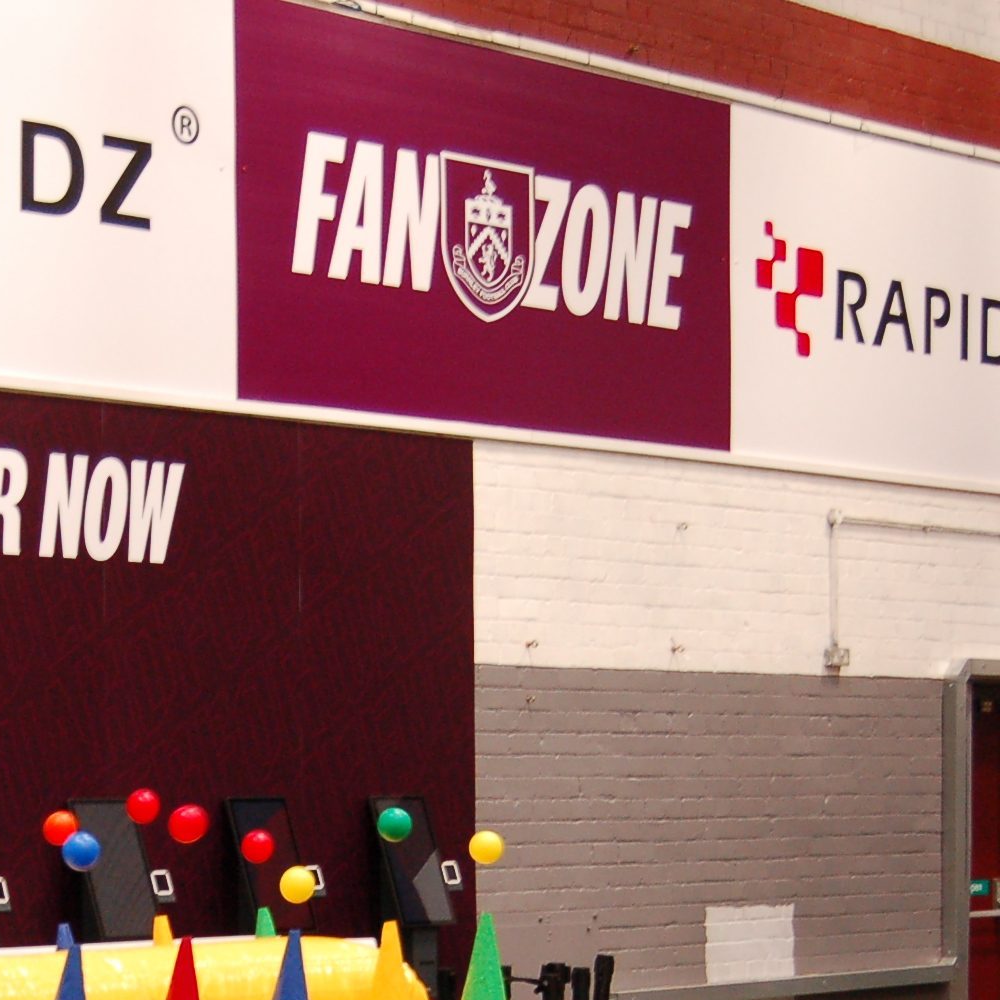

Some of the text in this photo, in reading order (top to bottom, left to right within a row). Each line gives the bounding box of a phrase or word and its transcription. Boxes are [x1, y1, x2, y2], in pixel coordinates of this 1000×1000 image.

[291, 130, 692, 330] FAN ZONE
[38, 452, 186, 565] NOW
